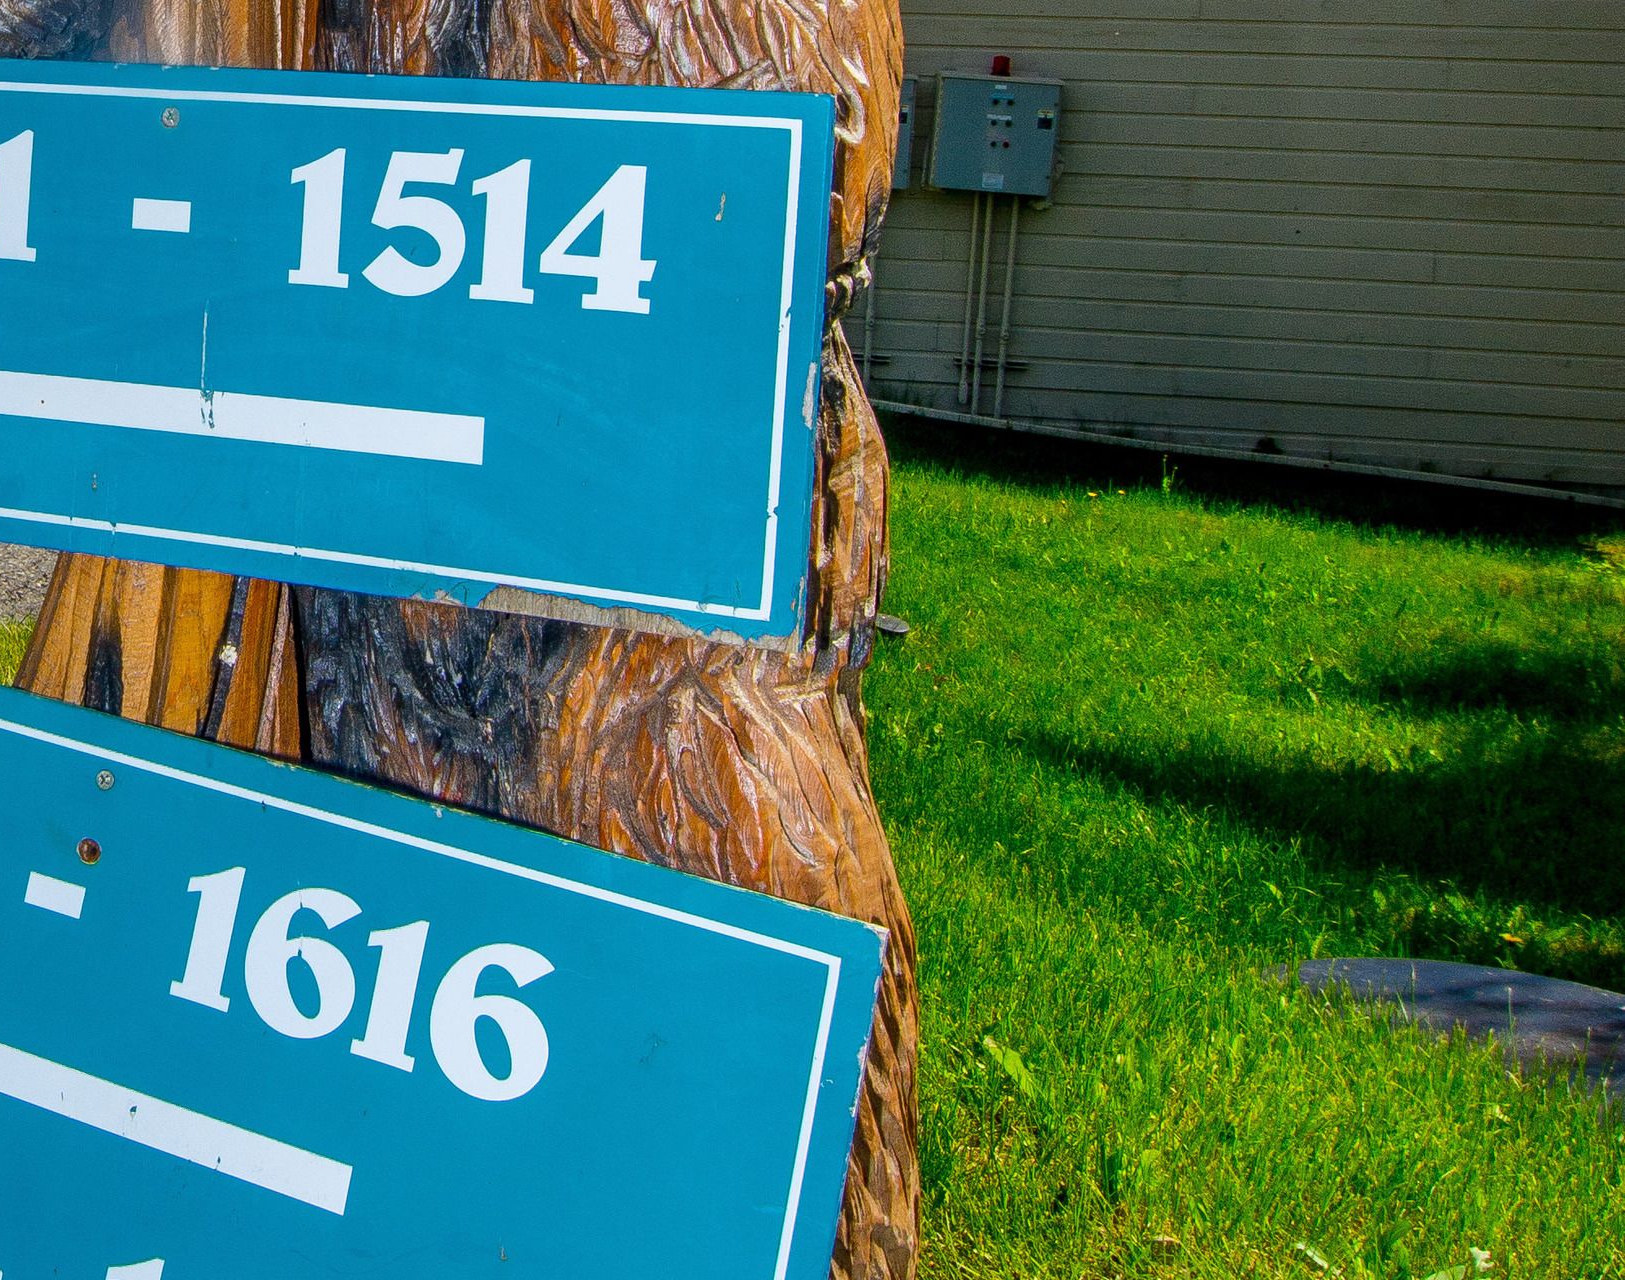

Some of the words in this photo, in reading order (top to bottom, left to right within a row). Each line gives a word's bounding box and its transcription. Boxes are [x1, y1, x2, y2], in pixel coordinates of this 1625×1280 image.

[133, 199, 191, 232] -
[289, 148, 657, 314] 1514
[25, 872, 85, 918] -
[171, 867, 555, 1102] 1616
